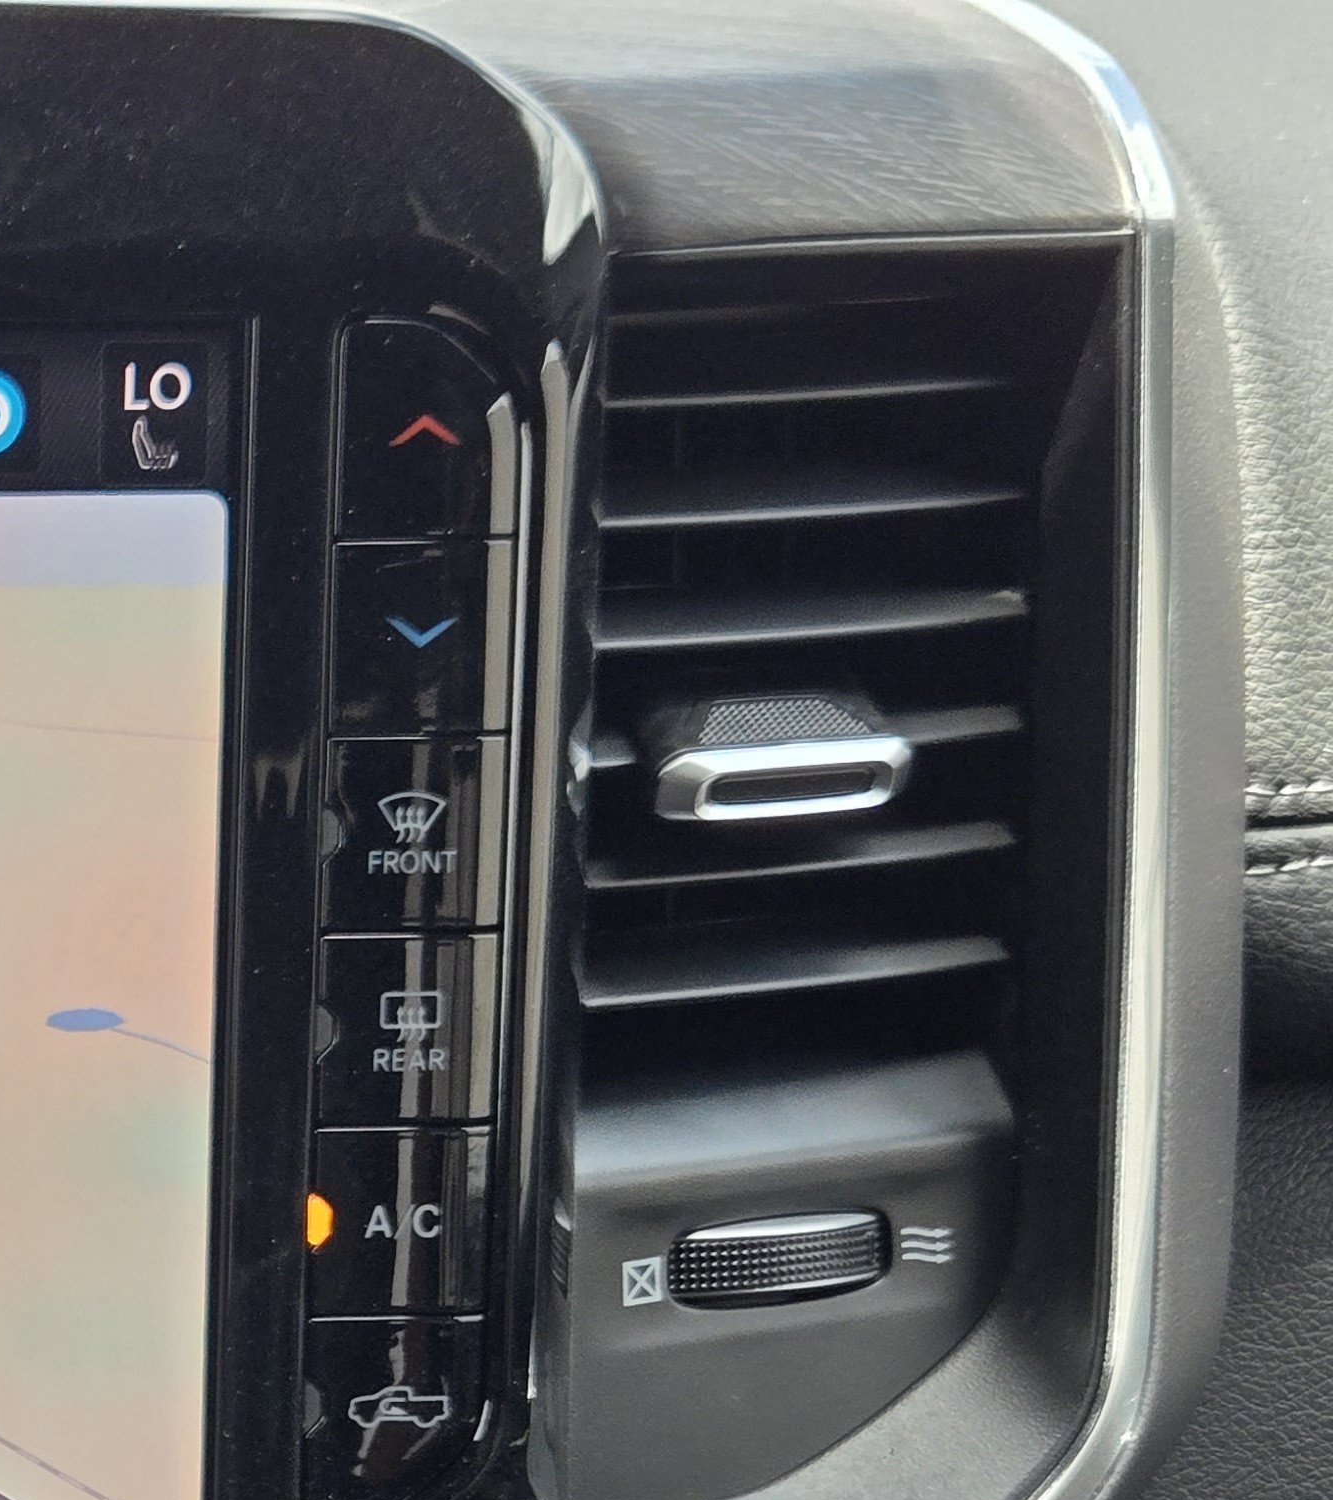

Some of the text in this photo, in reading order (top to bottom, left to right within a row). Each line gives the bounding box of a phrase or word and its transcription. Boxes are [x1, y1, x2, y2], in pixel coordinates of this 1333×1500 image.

[123, 361, 193, 411] LO
[368, 849, 458, 875] FRONT
[373, 1047, 445, 1072] REAR
[363, 1205, 442, 1240] A/C
